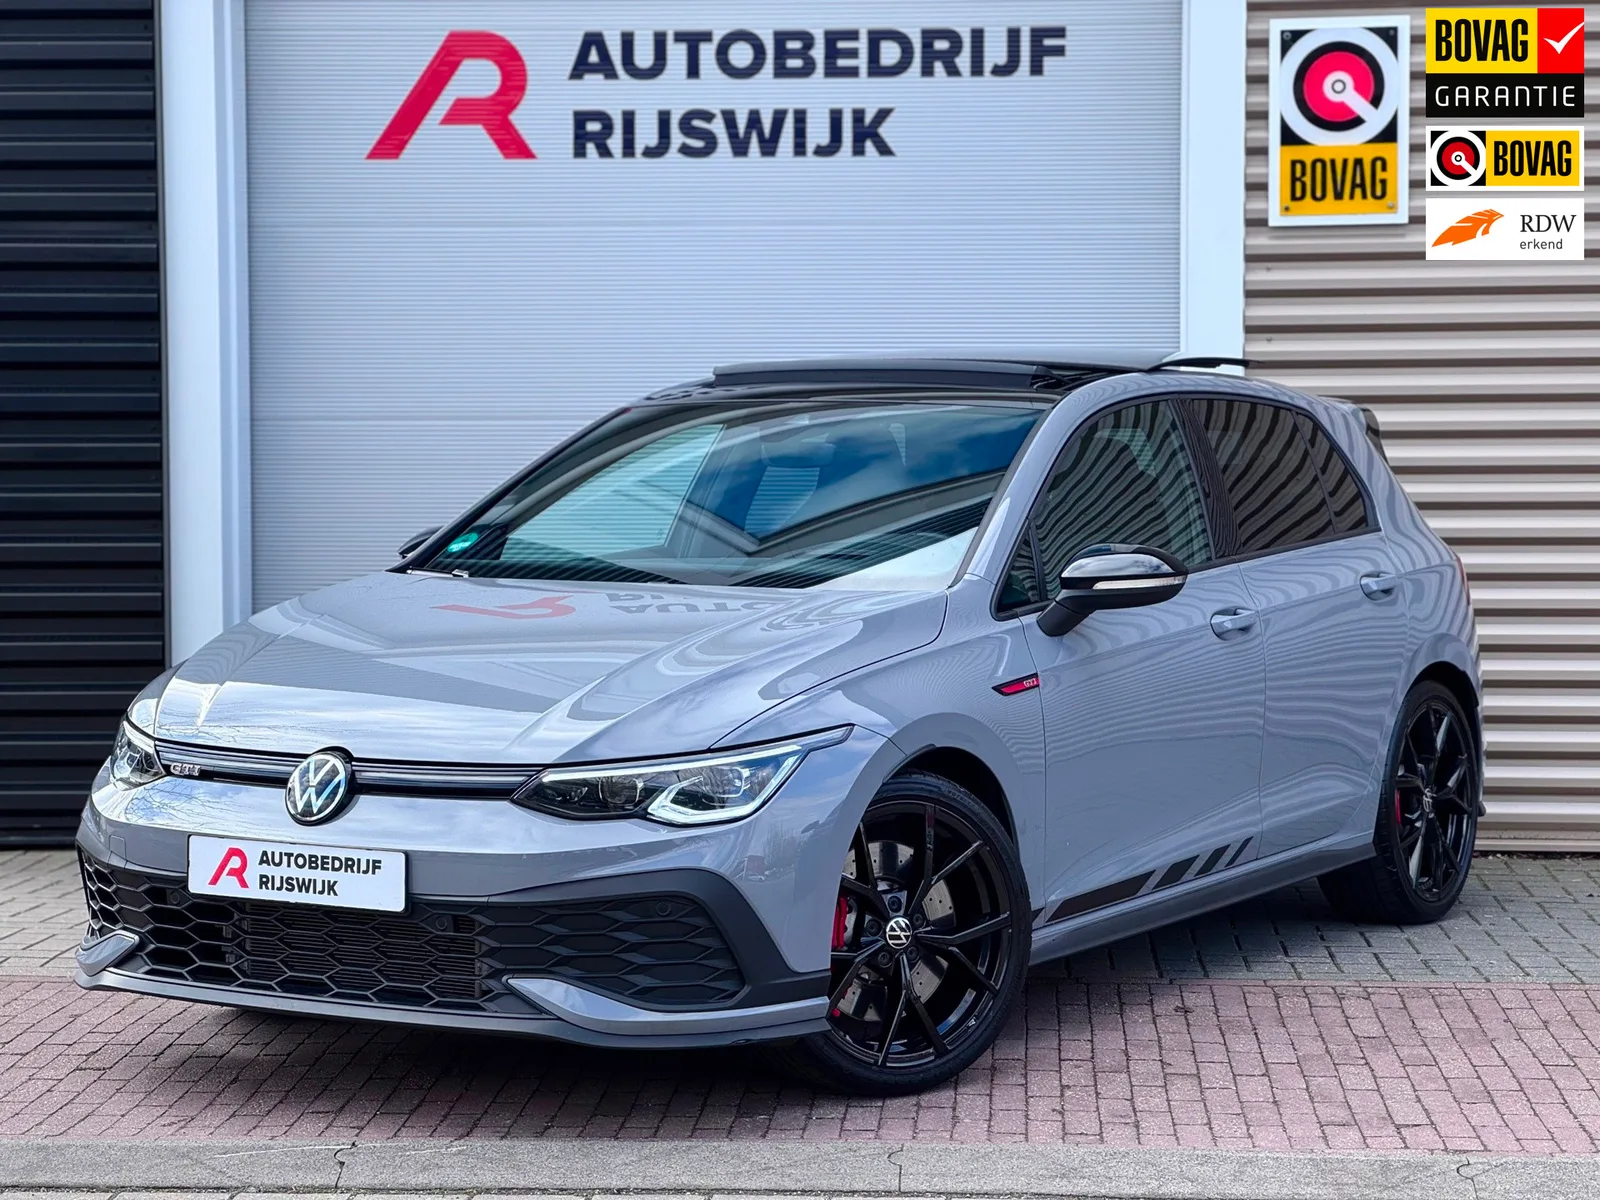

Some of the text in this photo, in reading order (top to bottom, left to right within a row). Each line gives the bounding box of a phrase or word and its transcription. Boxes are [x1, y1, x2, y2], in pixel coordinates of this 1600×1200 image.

[568, 26, 1067, 80] AUTOBEDRIJF
[572, 107, 897, 159] RIJSWIJK
[1290, 156, 1388, 203] BOVAG
[1023, 678, 1038, 688] GTI
[170, 762, 201, 776] GTI
[257, 850, 382, 876] AUTOBEDRIJF
[258, 874, 339, 897] RIJSWIJK
